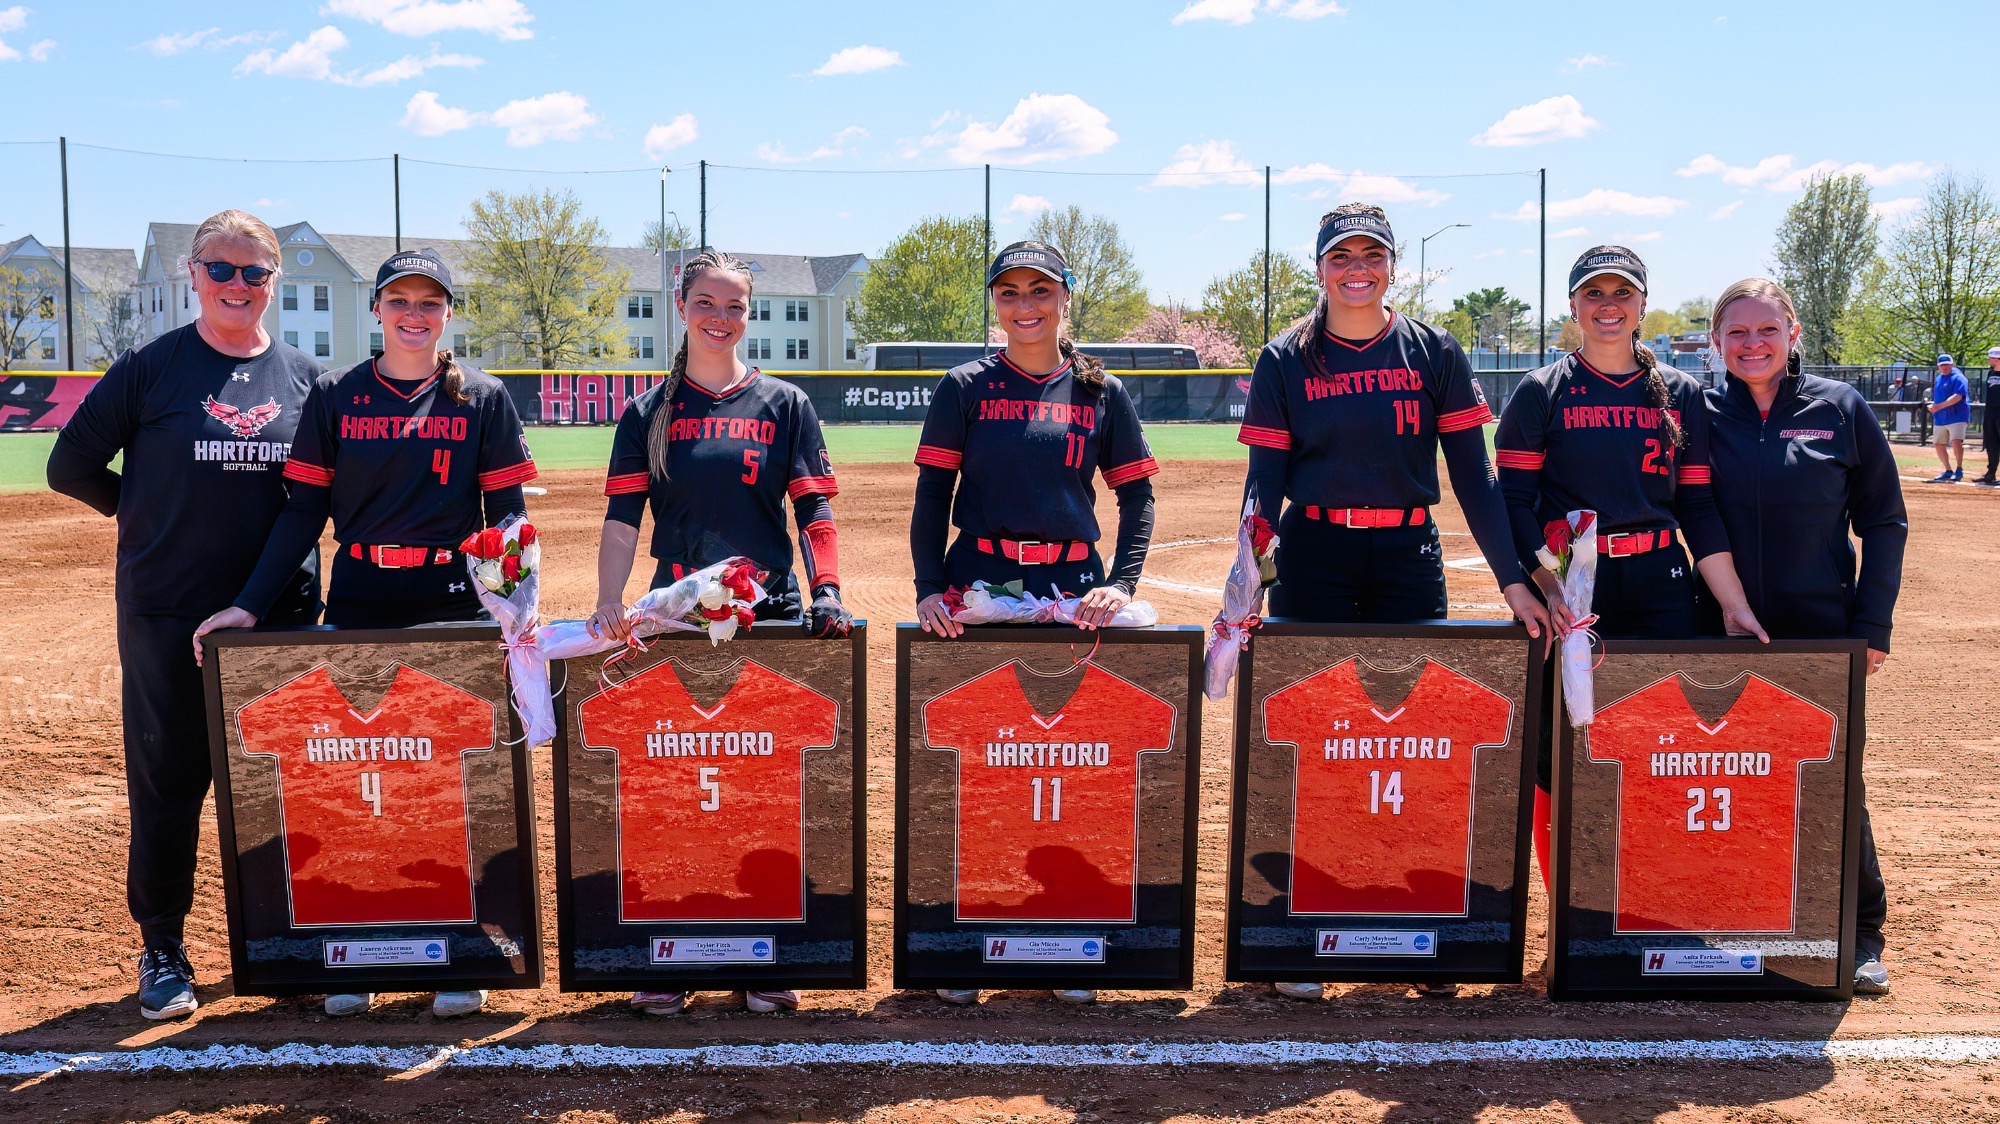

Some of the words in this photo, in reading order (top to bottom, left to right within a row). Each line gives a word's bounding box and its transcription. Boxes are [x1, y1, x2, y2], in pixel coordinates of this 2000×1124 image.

[1334, 217, 1376, 230] HARTFORD
[394, 257, 438, 272] HARTFORD
[1004, 251, 1045, 263] HARTFORD
[1588, 255, 1630, 266] HARTFORD
[1304, 367, 1422, 401] HARTFORD
[845, 386, 932, 410] #Capit
[979, 398, 1095, 430] HARTFORD
[1393, 400, 1420, 435] 14
[341, 414, 467, 441] HARTFORD
[666, 417, 776, 445] ARTFORD
[194, 440, 292, 462] HARTFORD
[1065, 432, 1085, 469] 11
[223, 462, 268, 471] SOFTBALL
[432, 448, 451, 485] 4
[742, 448, 760, 485] 5
[306, 736, 432, 762] HARTFORD
[646, 732, 774, 758] HARTFORD
[986, 742, 1110, 767] HARTFORD
[1324, 736, 1452, 760] HARTFORD
[1650, 752, 1772, 776] HARTFORD
[360, 772, 382, 817] 4
[699, 766, 720, 812] 5
[1030, 776, 1062, 822] 11
[1369, 770, 1404, 815] 14
[1686, 786, 1731, 832] 23
[332, 946, 348, 962] H
[658, 941, 675, 958] H
[990, 940, 1007, 956] H
[1322, 934, 1339, 950] H
[1648, 953, 1665, 970] H
